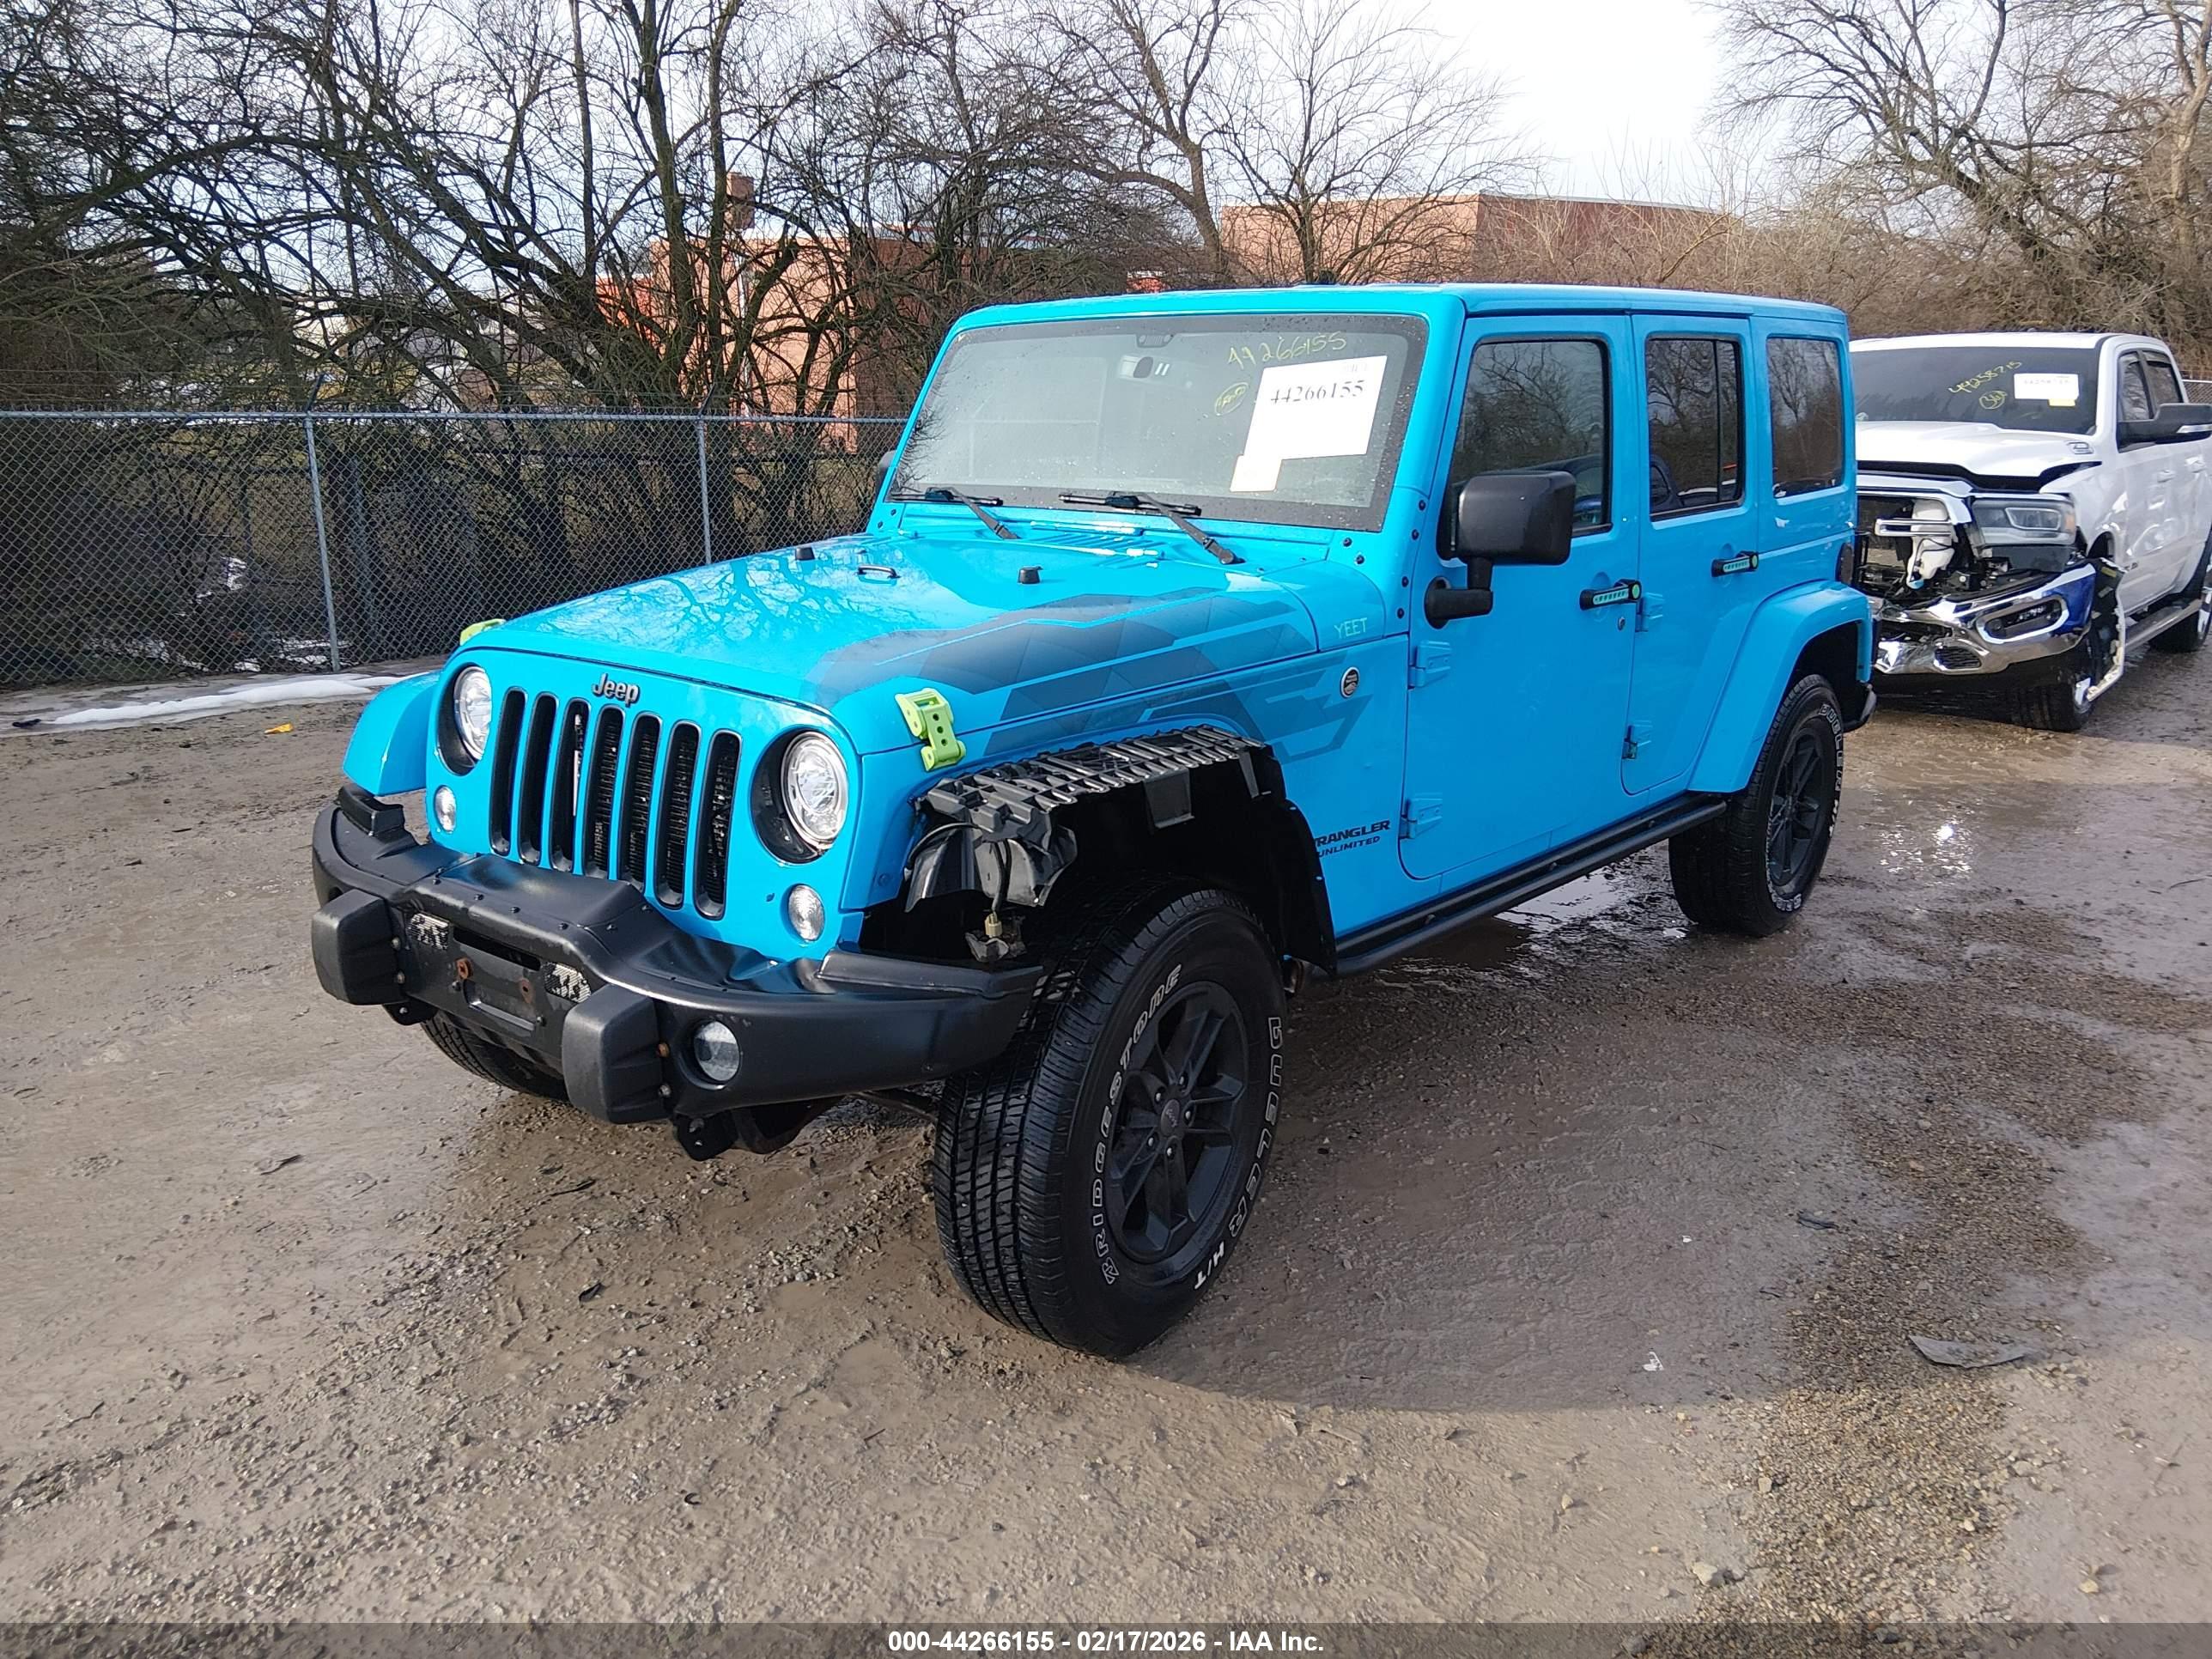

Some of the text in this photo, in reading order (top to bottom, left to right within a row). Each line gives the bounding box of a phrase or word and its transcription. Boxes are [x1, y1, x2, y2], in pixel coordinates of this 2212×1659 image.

[1270, 380, 1365, 404] 44266155
[1334, 617, 1368, 639] YEET
[592, 672, 641, 708] Jeep
[1314, 820, 1391, 848] RANGLER
[1091, 963, 1182, 1285] BRIDGESTONE
[1228, 1017, 1284, 1237] DUELER
